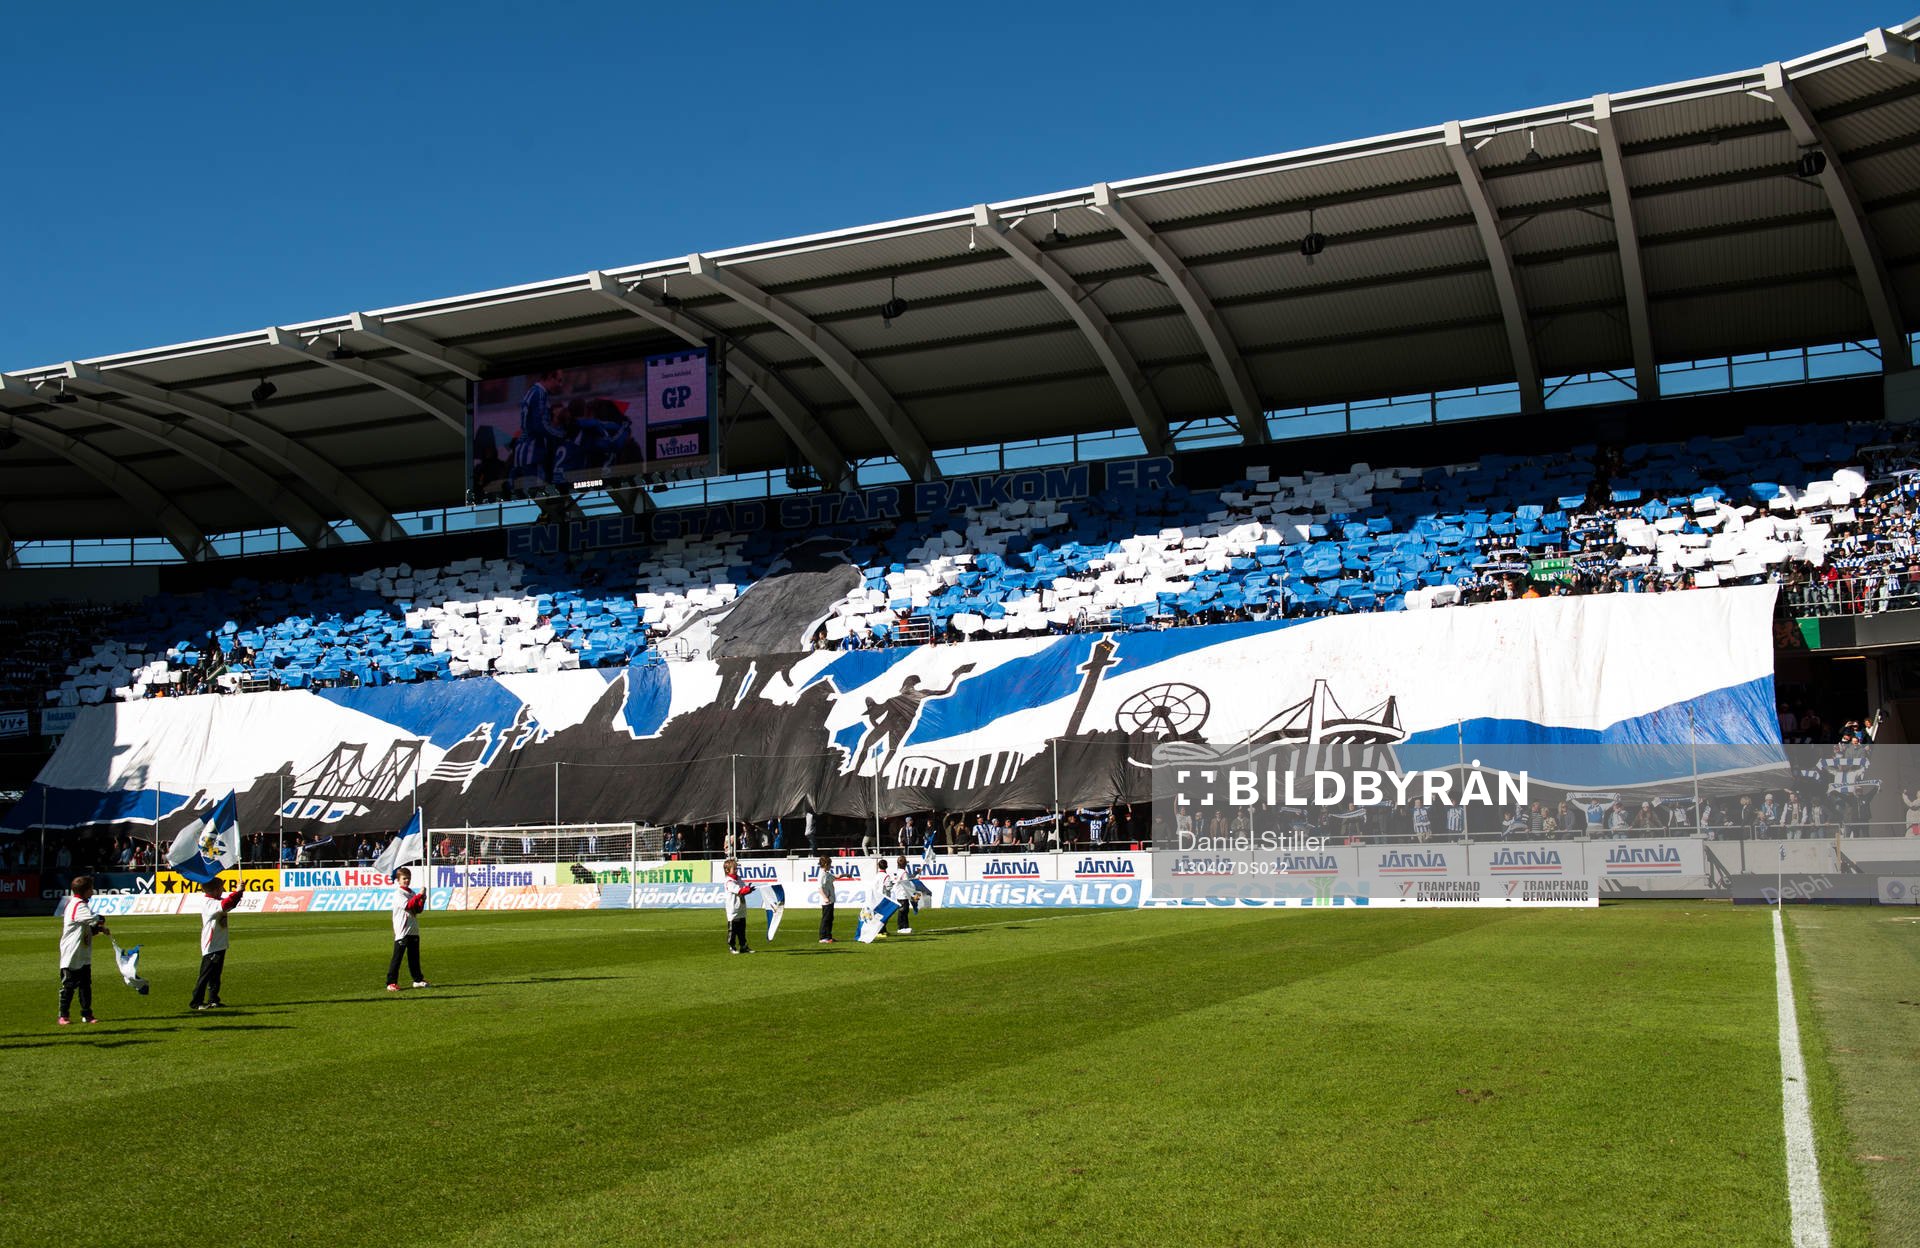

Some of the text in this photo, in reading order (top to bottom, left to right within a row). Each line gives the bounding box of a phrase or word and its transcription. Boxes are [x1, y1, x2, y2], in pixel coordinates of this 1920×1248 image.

[662, 386, 691, 409] GP
[658, 440, 697, 456] Ventab
[573, 479, 603, 489] SAMSUNG
[505, 523, 560, 557] EN
[569, 512, 646, 549] HEL
[650, 501, 767, 543] STAD
[914, 463, 1090, 513] BAKOM
[1104, 456, 1175, 491] ER
[807, 861, 861, 877] JÄNIA
[284, 870, 341, 887] FRIGGA
[1417, 881, 1481, 891] TRANPENAD
[1523, 880, 1589, 891] TRANPENAD
[950, 883, 1133, 905] Nilfisk-ALTO
[1522, 891, 1589, 902] BEMANNING
[1760, 874, 1834, 905] Delphi
